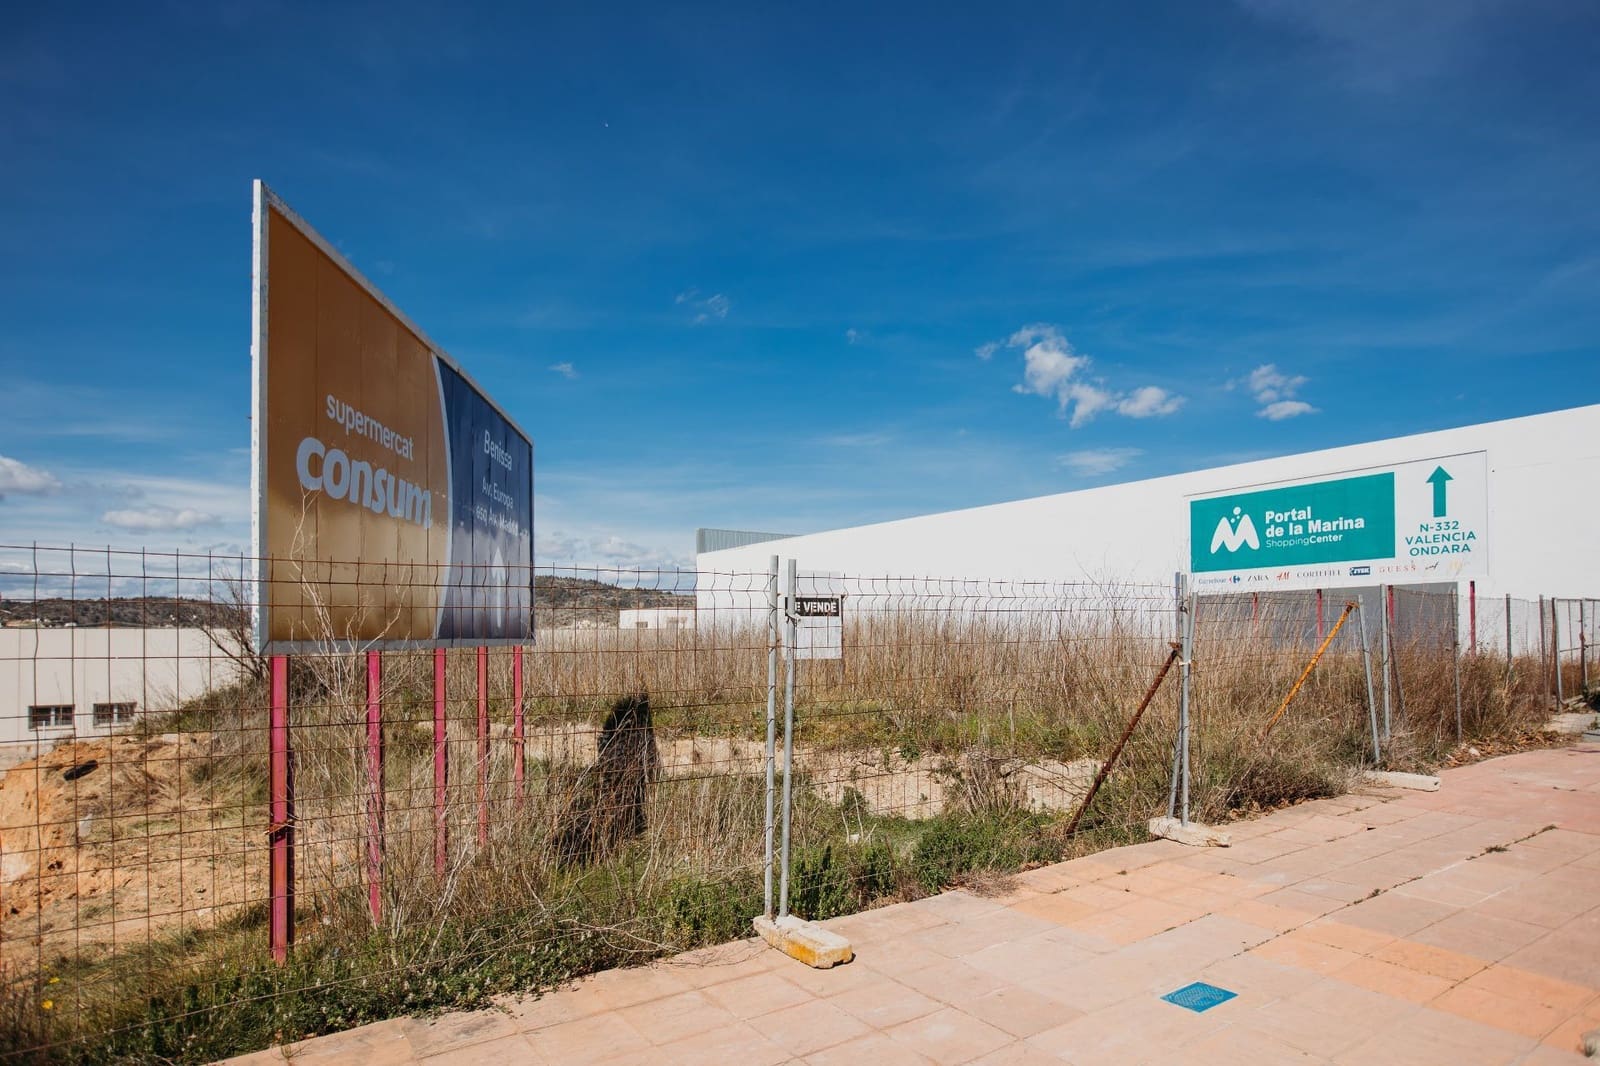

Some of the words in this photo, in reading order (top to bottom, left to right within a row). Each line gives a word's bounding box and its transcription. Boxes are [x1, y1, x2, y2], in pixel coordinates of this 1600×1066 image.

[326, 394, 414, 461] supermercat
[483, 429, 512, 471] Benissa
[296, 437, 432, 529] consum
[493, 483, 513, 510] Europa
[1265, 506, 1311, 524] Portal
[1265, 525, 1284, 538] de
[1289, 522, 1303, 535] la
[1308, 517, 1365, 534] Marina
[1420, 520, 1459, 532] N-332
[1405, 530, 1476, 545] VALENCIA
[1409, 543, 1471, 557] ONDARA
[803, 601, 837, 613] VENDE
